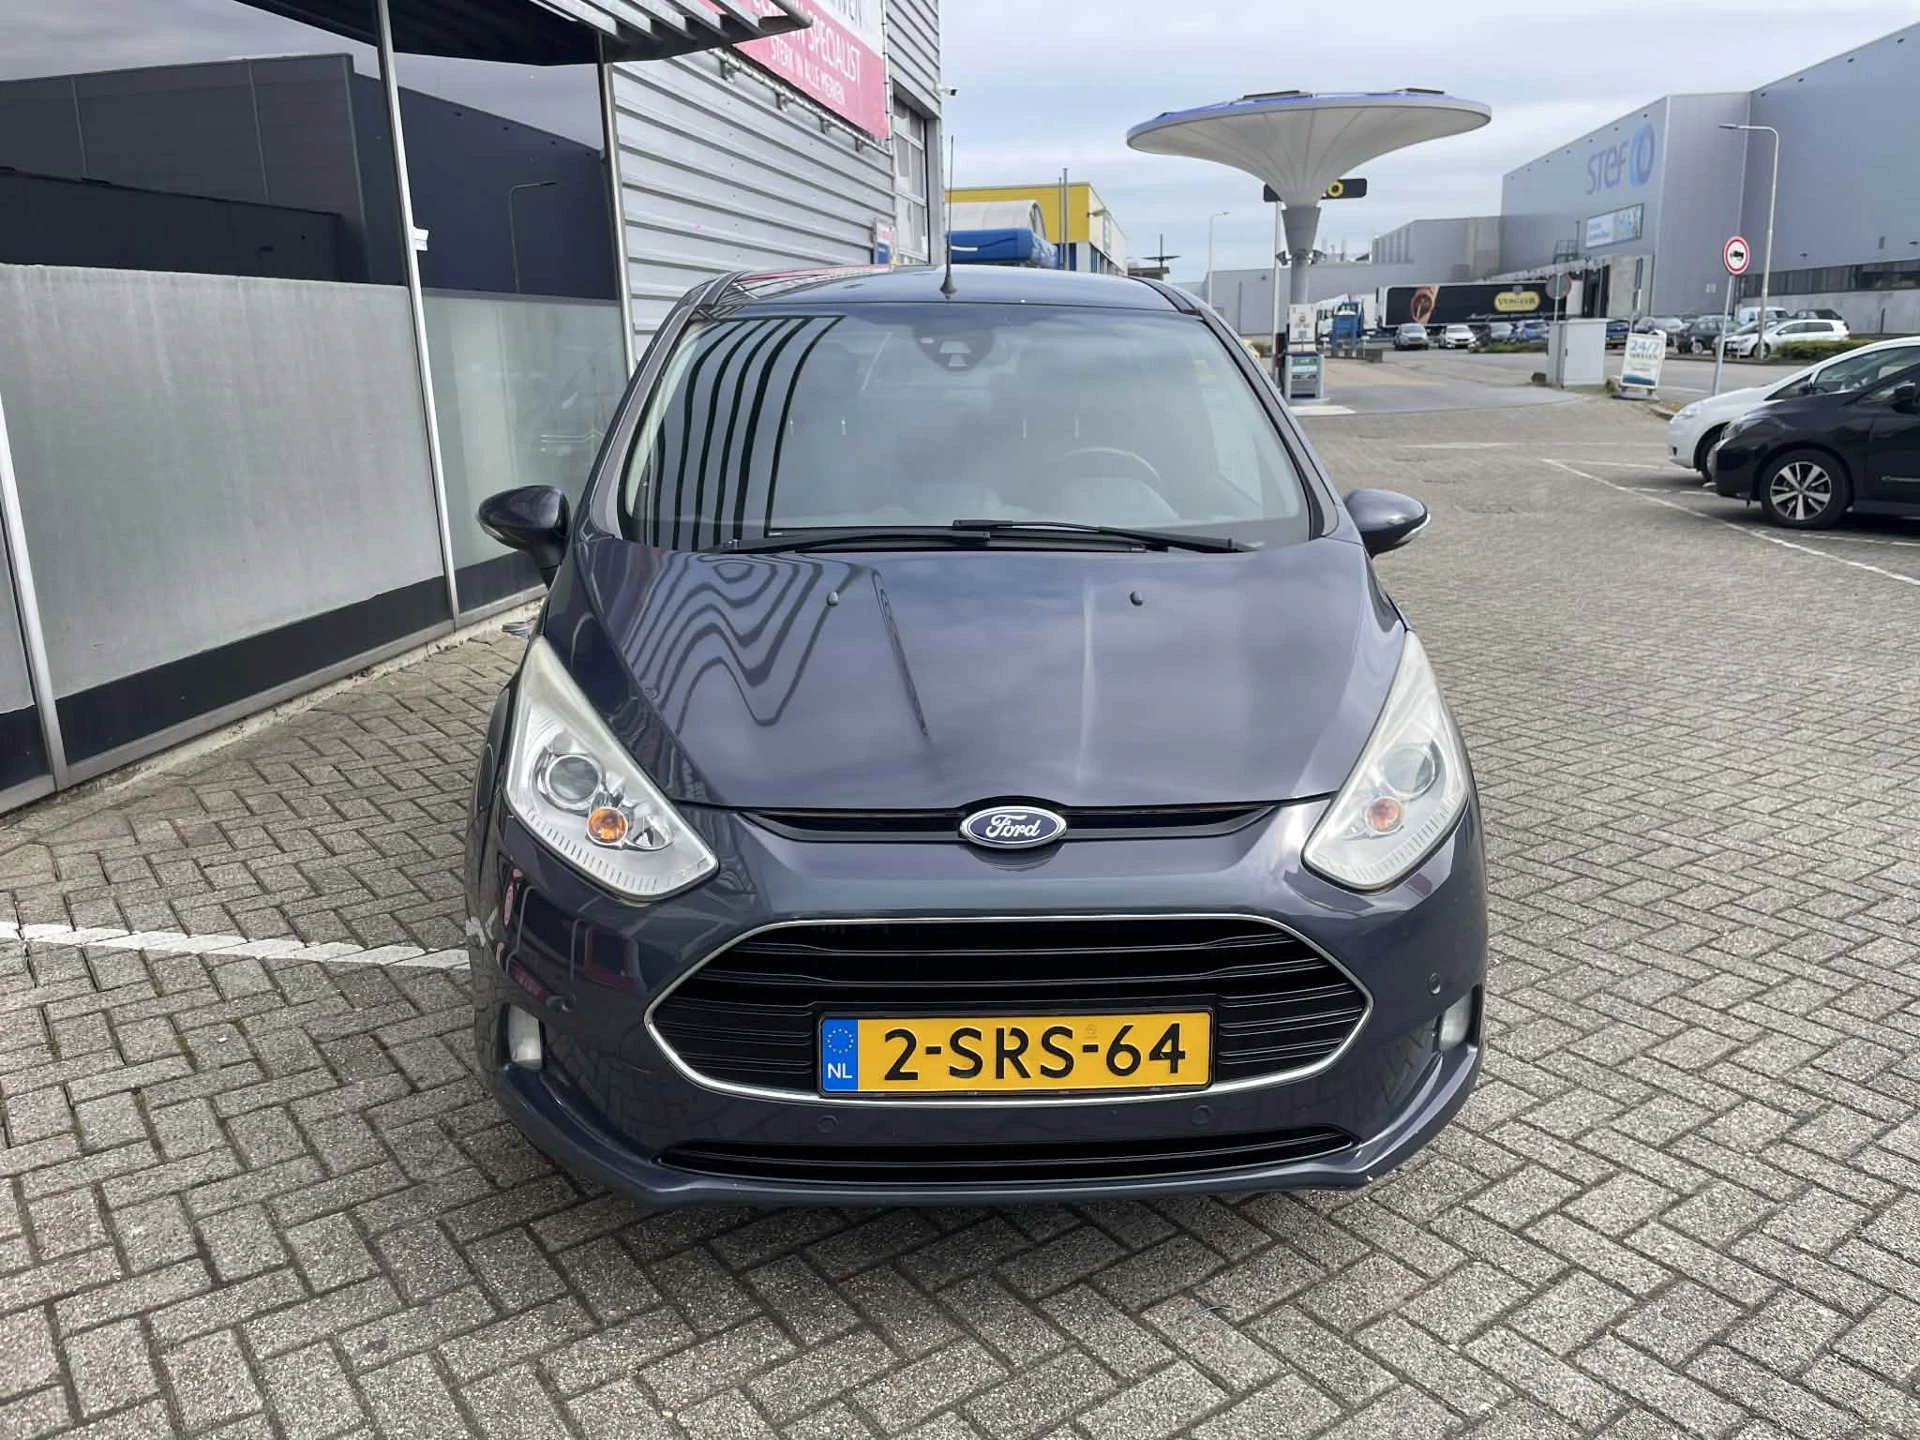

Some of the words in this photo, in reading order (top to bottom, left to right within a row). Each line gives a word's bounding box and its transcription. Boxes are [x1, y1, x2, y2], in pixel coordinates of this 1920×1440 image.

[985, 814, 1041, 838] Ford
[827, 1062, 853, 1080] NL
[883, 1022, 1187, 1081] 2-SRS-64
